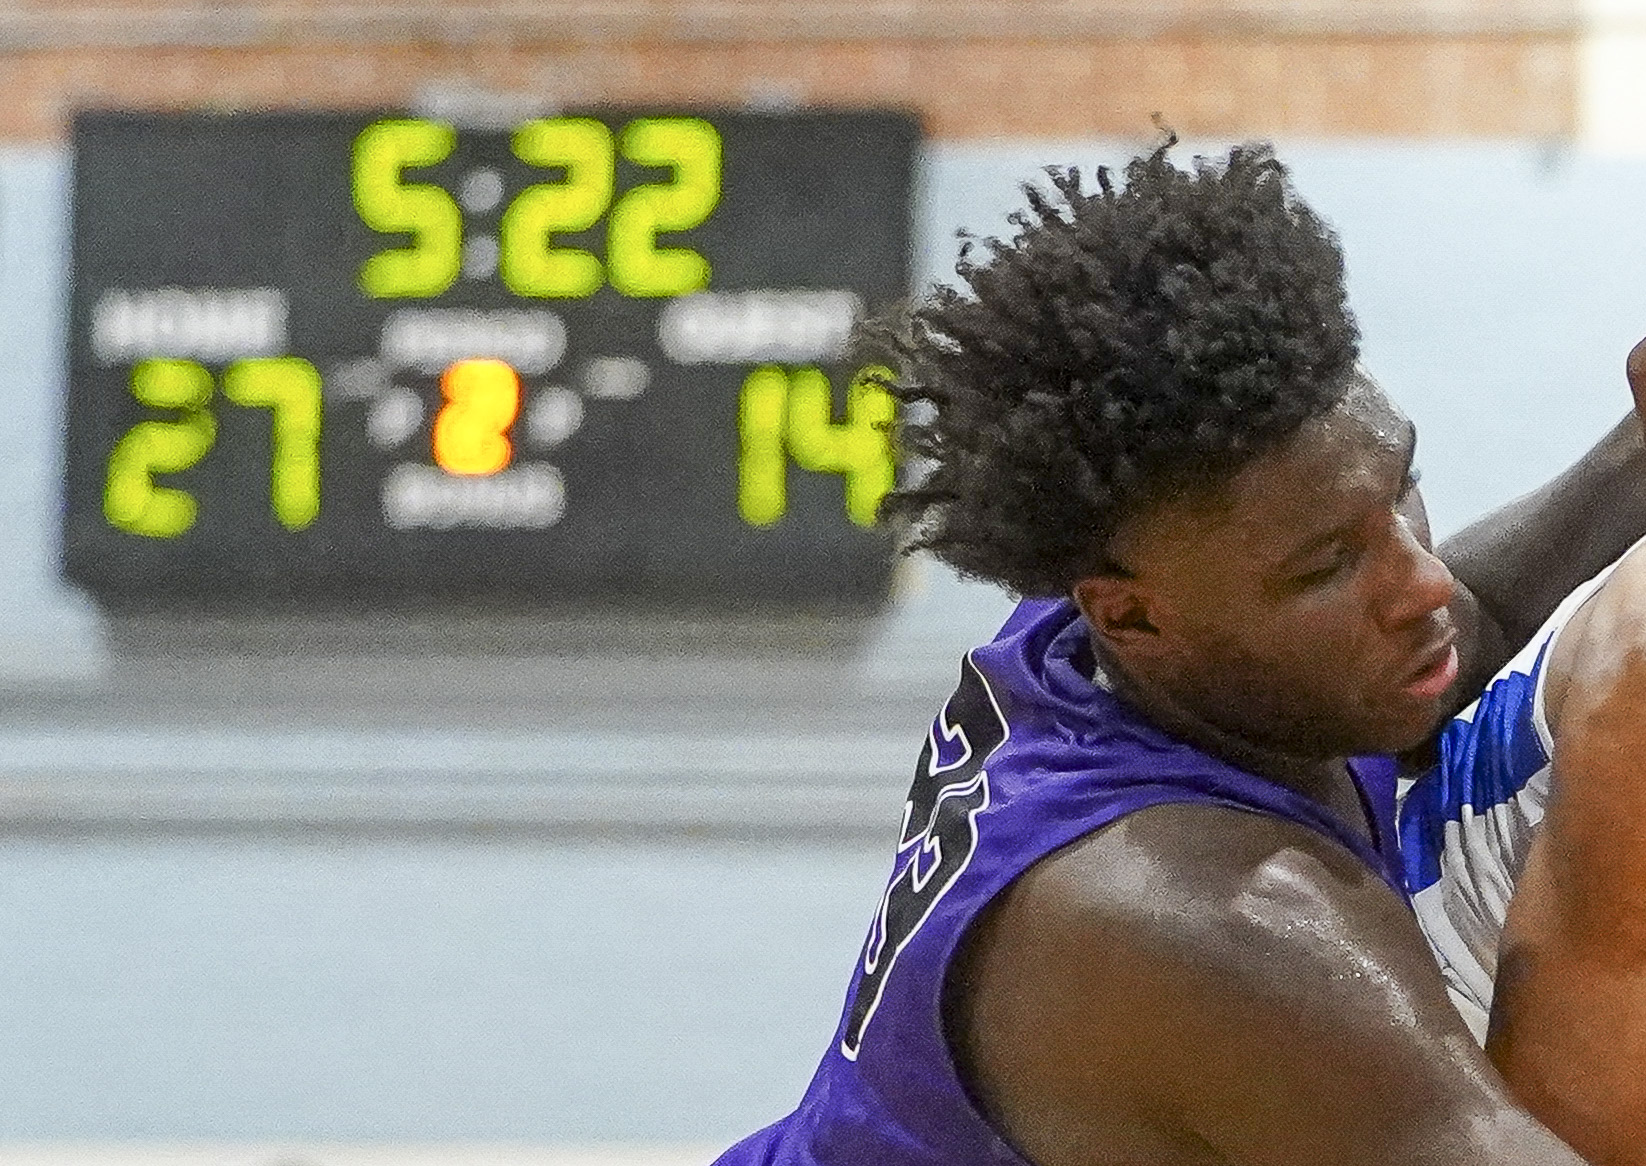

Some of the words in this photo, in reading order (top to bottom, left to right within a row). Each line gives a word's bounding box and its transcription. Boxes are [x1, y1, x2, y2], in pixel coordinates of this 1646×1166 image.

[352, 118, 723, 298] 5:22
[104, 357, 322, 537] 27
[738, 363, 897, 528] 14
